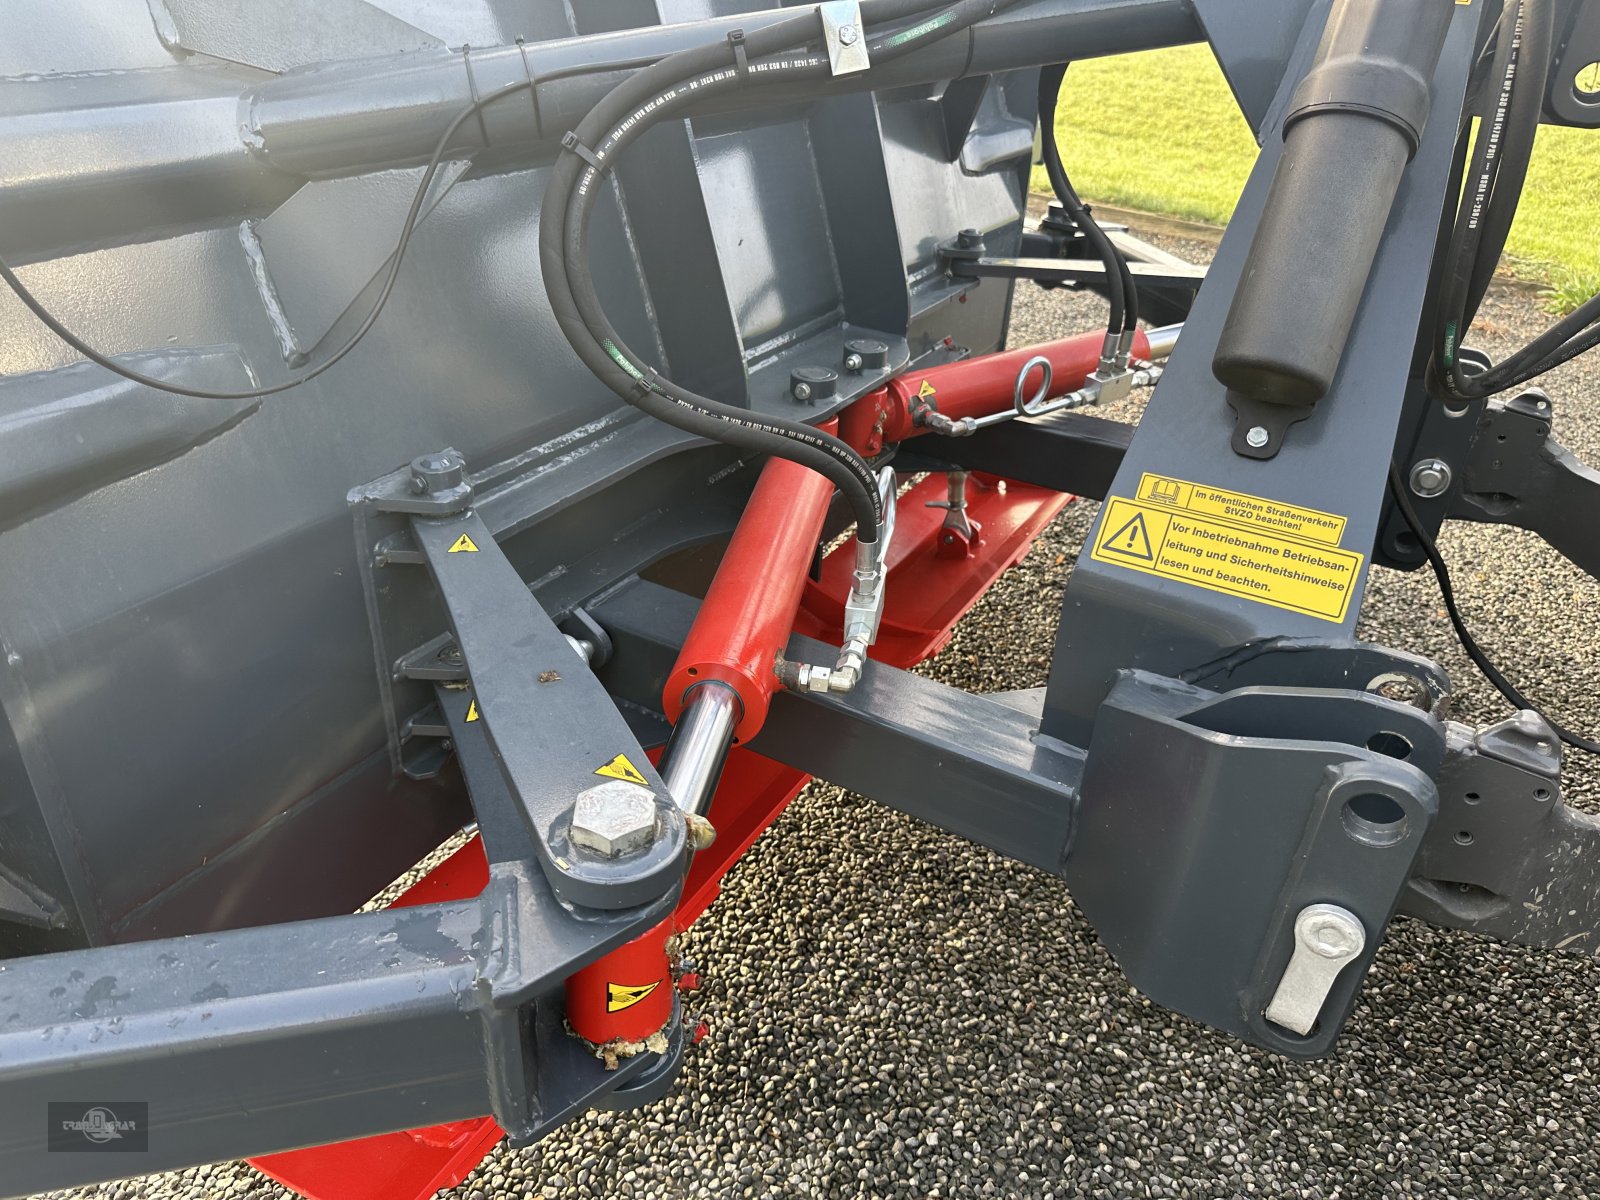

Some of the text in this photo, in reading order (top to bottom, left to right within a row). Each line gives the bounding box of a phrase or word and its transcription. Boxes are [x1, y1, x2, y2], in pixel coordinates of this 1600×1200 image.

[1503, 80, 1512, 90] WP
[1506, 64, 1515, 78] MAX
[1495, 108, 1505, 121] BAR
[1195, 490, 1338, 530] Im öffentlichen Straßenverkehr
[1224, 505, 1302, 531] StVZO beachten!
[1172, 522, 1350, 573] Vor Inbetriebnahme Betriebsan-
[1160, 557, 1271, 592] lesen und beachten.
[1166, 539, 1345, 591] leitung und Sicherheitshinweise
